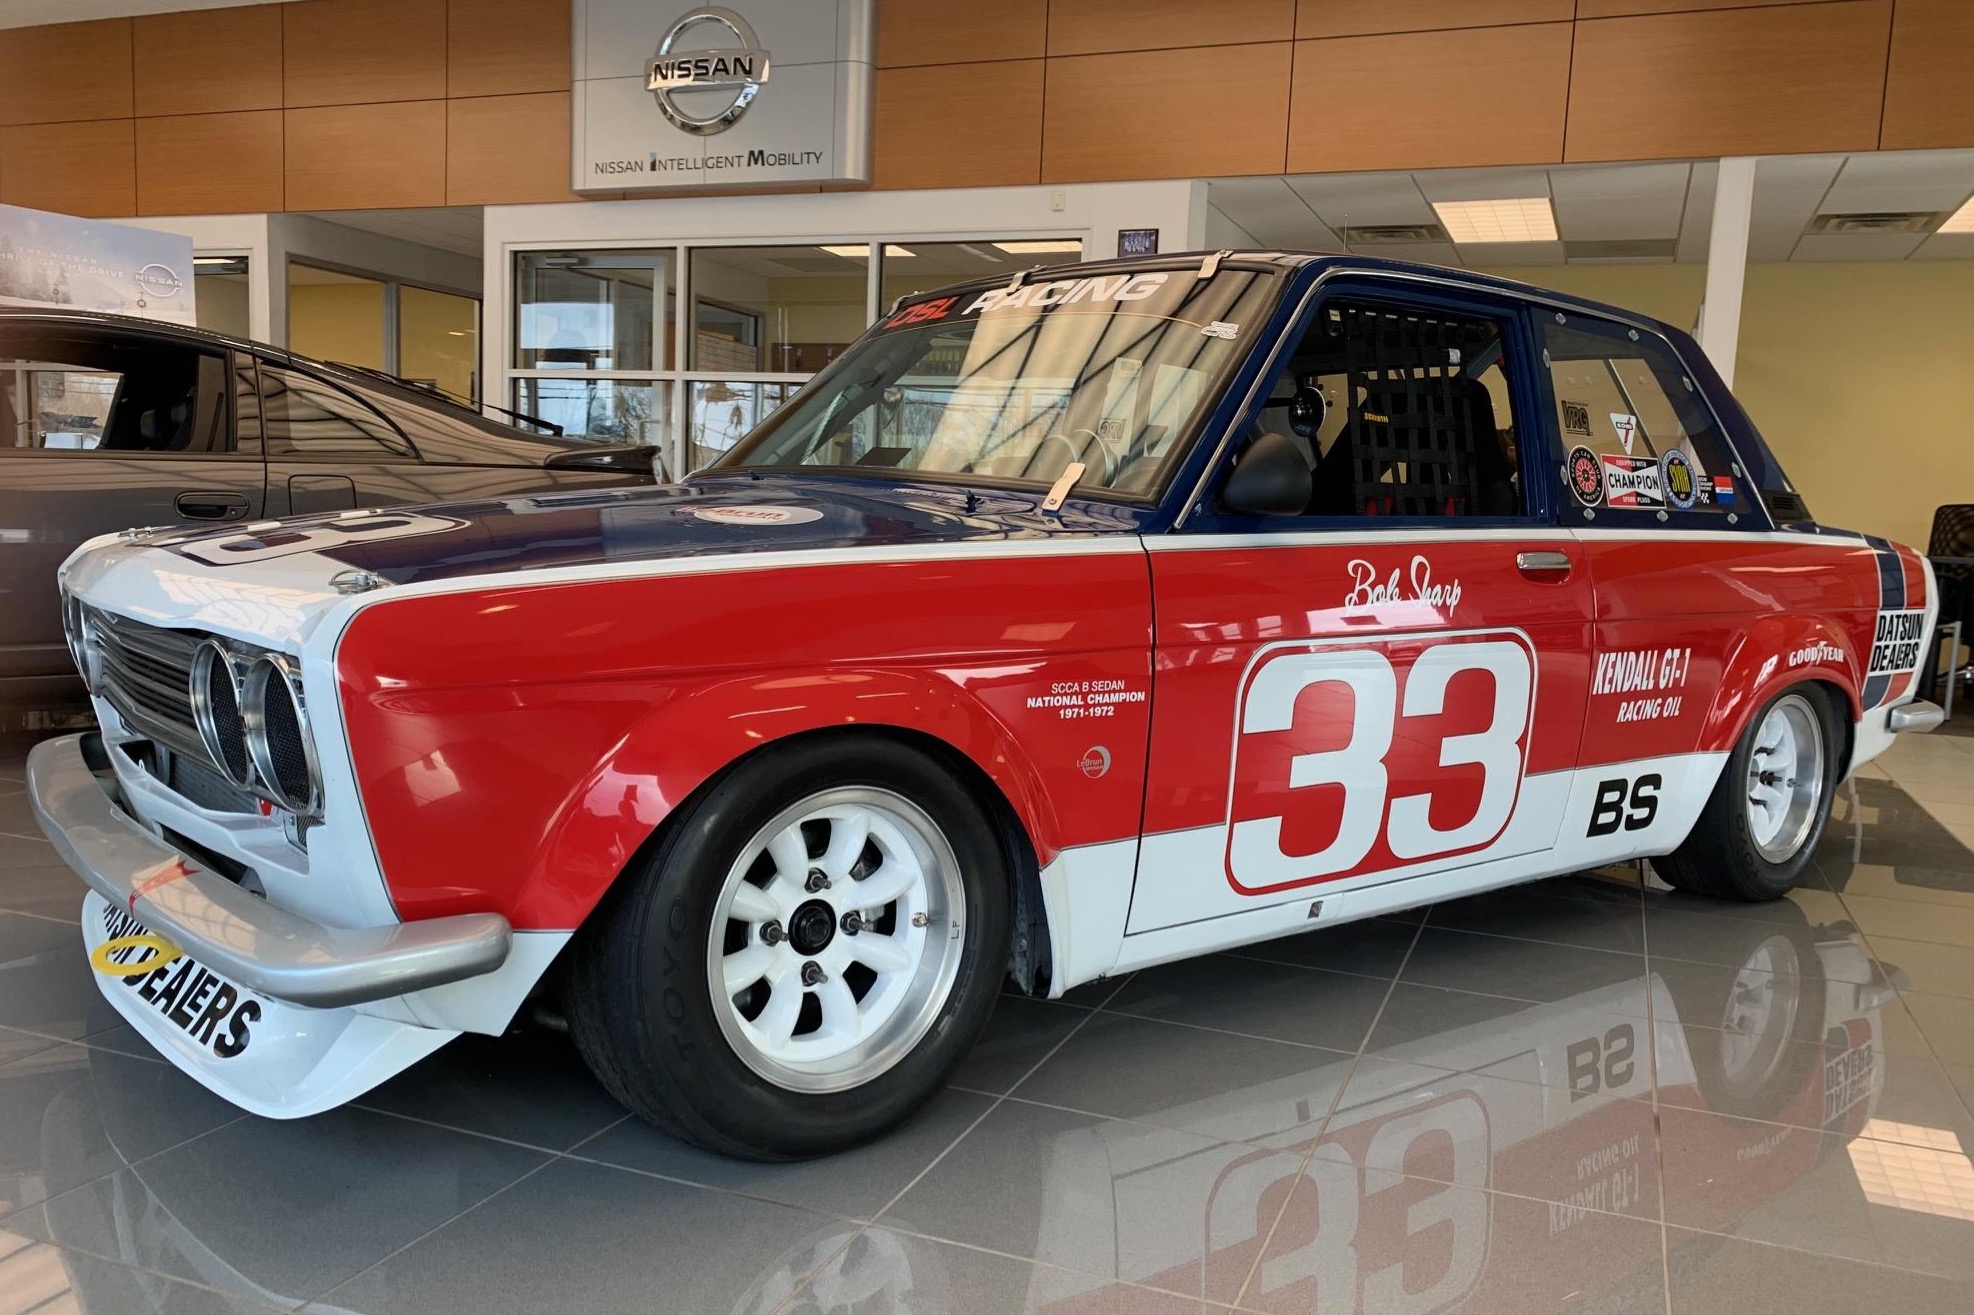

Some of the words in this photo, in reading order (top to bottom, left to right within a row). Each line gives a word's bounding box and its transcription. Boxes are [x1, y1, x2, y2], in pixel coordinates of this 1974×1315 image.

[653, 57, 753, 83] NISSAN
[594, 160, 644, 175] NISSAN
[650, 152, 744, 172] INTELLIGENT
[747, 149, 823, 167] MOBILITY
[90, 266, 125, 278] DRIVE
[135, 274, 183, 288] NISSAN
[961, 273, 1168, 315] RACING
[1609, 473, 1660, 490] CHAMPION
[1345, 559, 1402, 616] Bob
[1408, 555, 1461, 618] Sharp
[1876, 613, 1924, 642] DATSUN
[1789, 644, 1844, 667] GOODYEAR
[1870, 642, 1919, 672] DEALERS
[1593, 650, 1658, 695] KENDALL
[1659, 648, 1691, 690] GT-1
[1027, 695, 1084, 708] NATIONAL
[1087, 691, 1145, 704] CHAMPION
[1052, 682, 1078, 693] SCCA
[1082, 681, 1089, 692] B
[1091, 680, 1125, 691] SEDAN
[1059, 706, 1114, 719] 1971-1972
[1616, 698, 1662, 723] RACING
[1663, 696, 1682, 717] OIL
[1077, 758, 1103, 768] LeBrun
[1230, 641, 1531, 889] 33
[1586, 773, 1662, 838] BS
